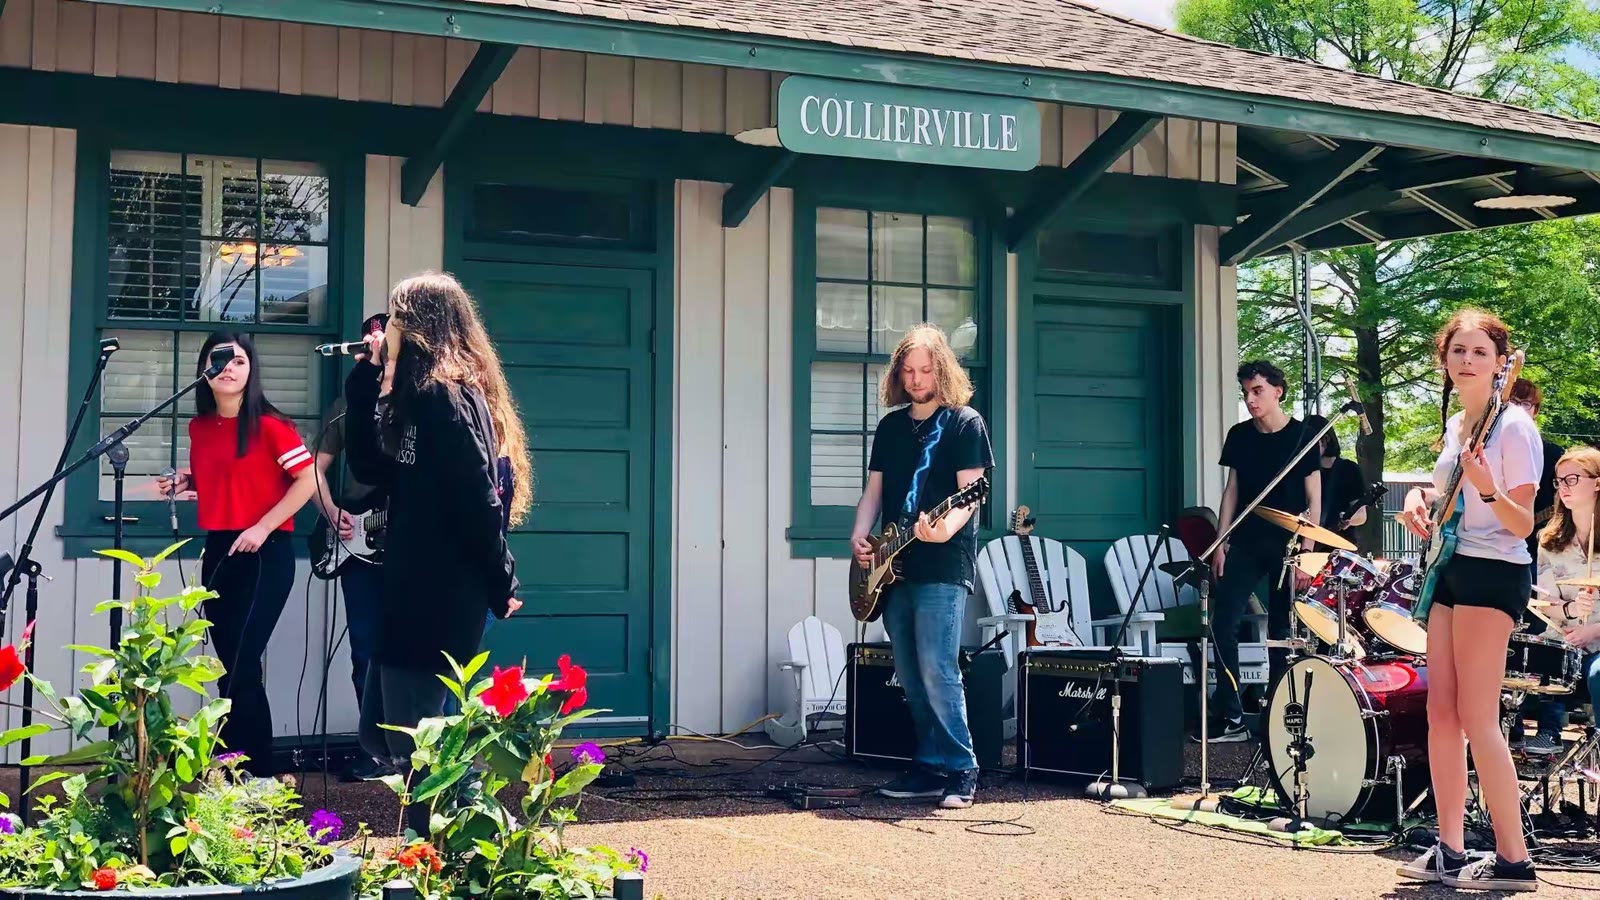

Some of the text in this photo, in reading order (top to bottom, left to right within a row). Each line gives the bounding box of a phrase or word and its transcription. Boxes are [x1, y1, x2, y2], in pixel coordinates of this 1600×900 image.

[800, 95, 1018, 152] COLLIERVILLE
[395, 449, 416, 465] ISCO
[1058, 681, 1107, 700] Marshll
